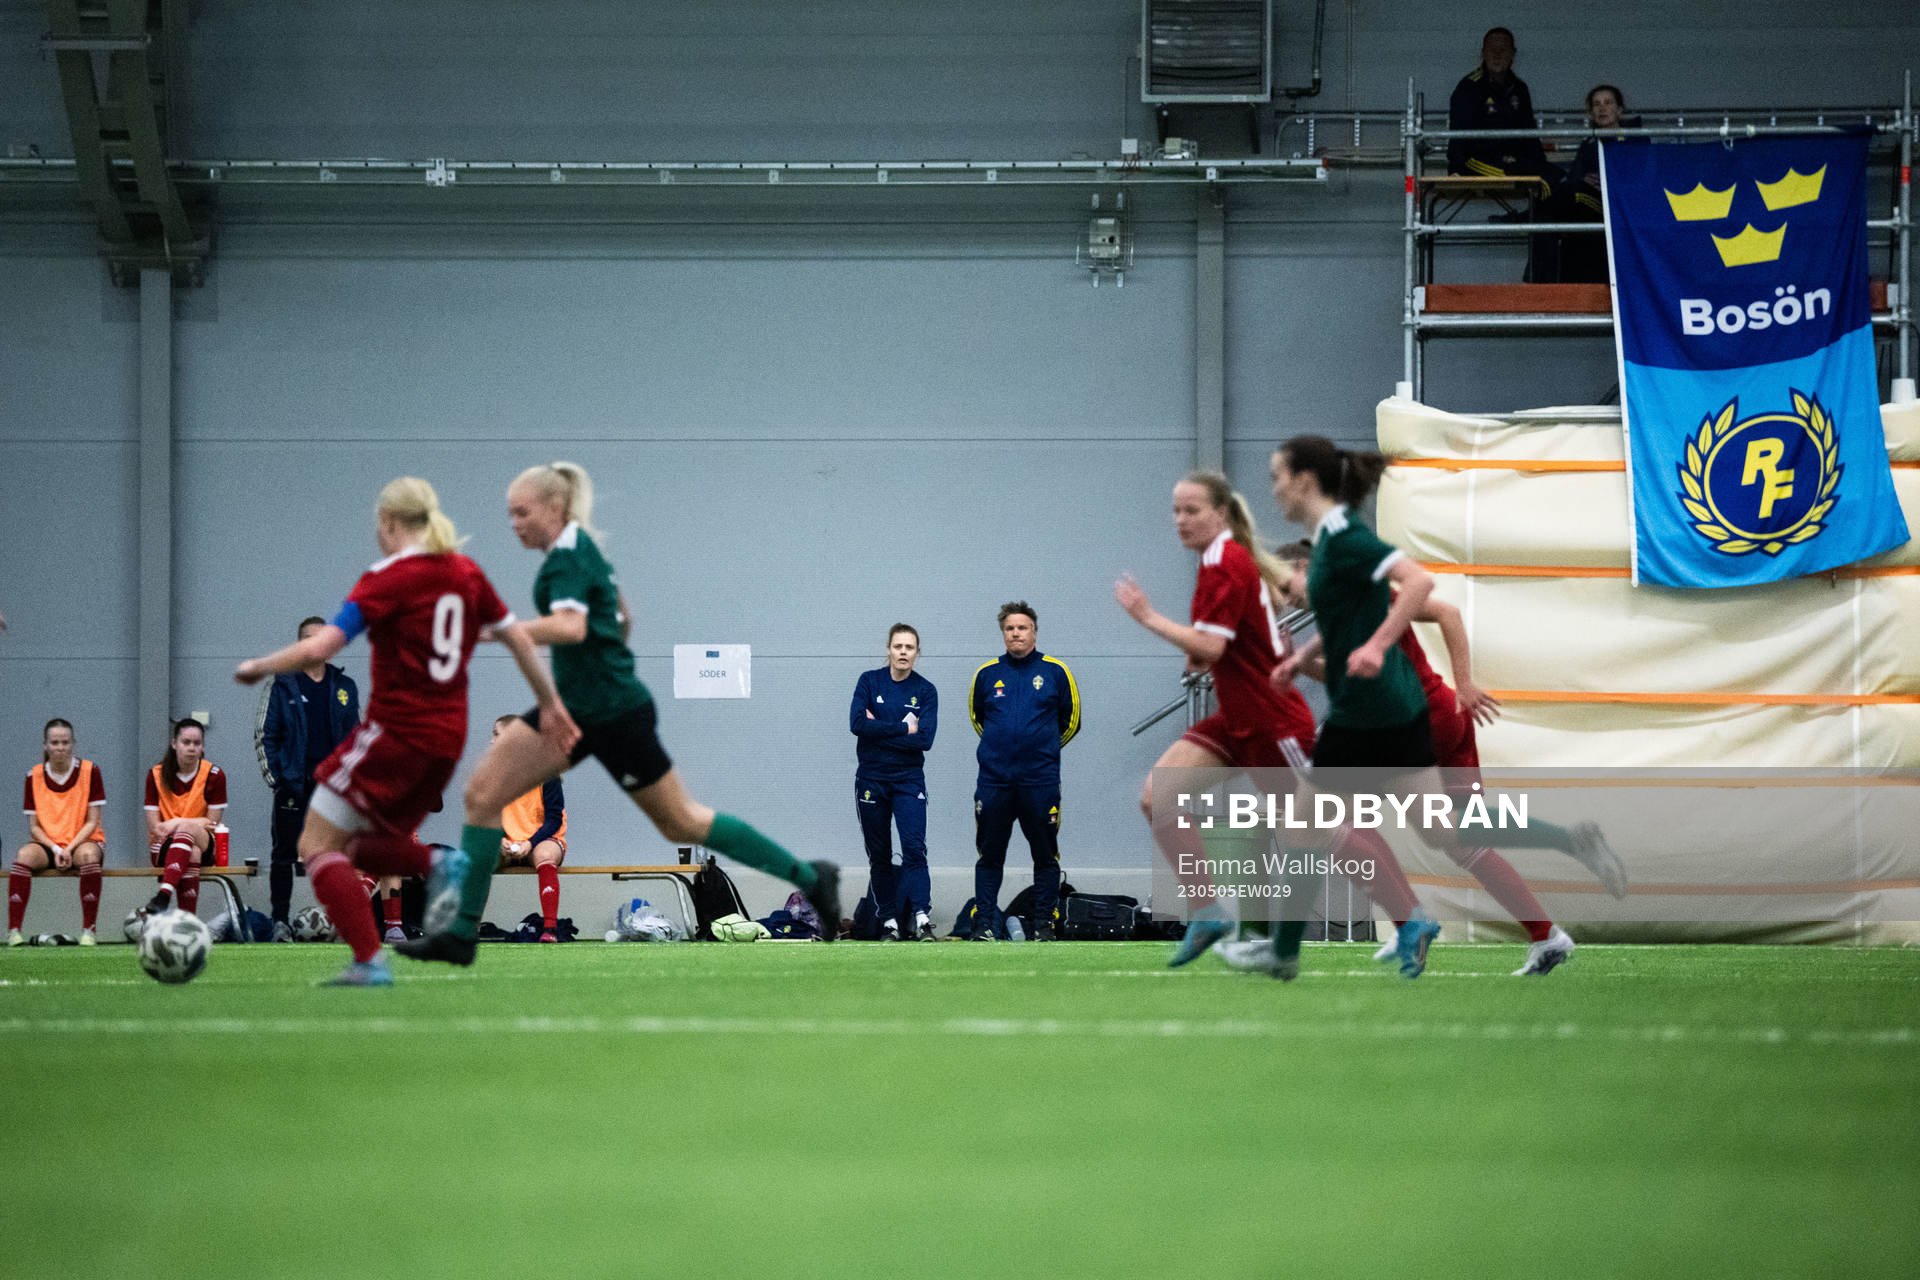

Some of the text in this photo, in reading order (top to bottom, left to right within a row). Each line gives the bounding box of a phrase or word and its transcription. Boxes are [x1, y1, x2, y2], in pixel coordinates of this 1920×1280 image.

[1680, 284, 1831, 336] Bosön
[1741, 437, 1795, 519] RF
[429, 592, 464, 682] 9
